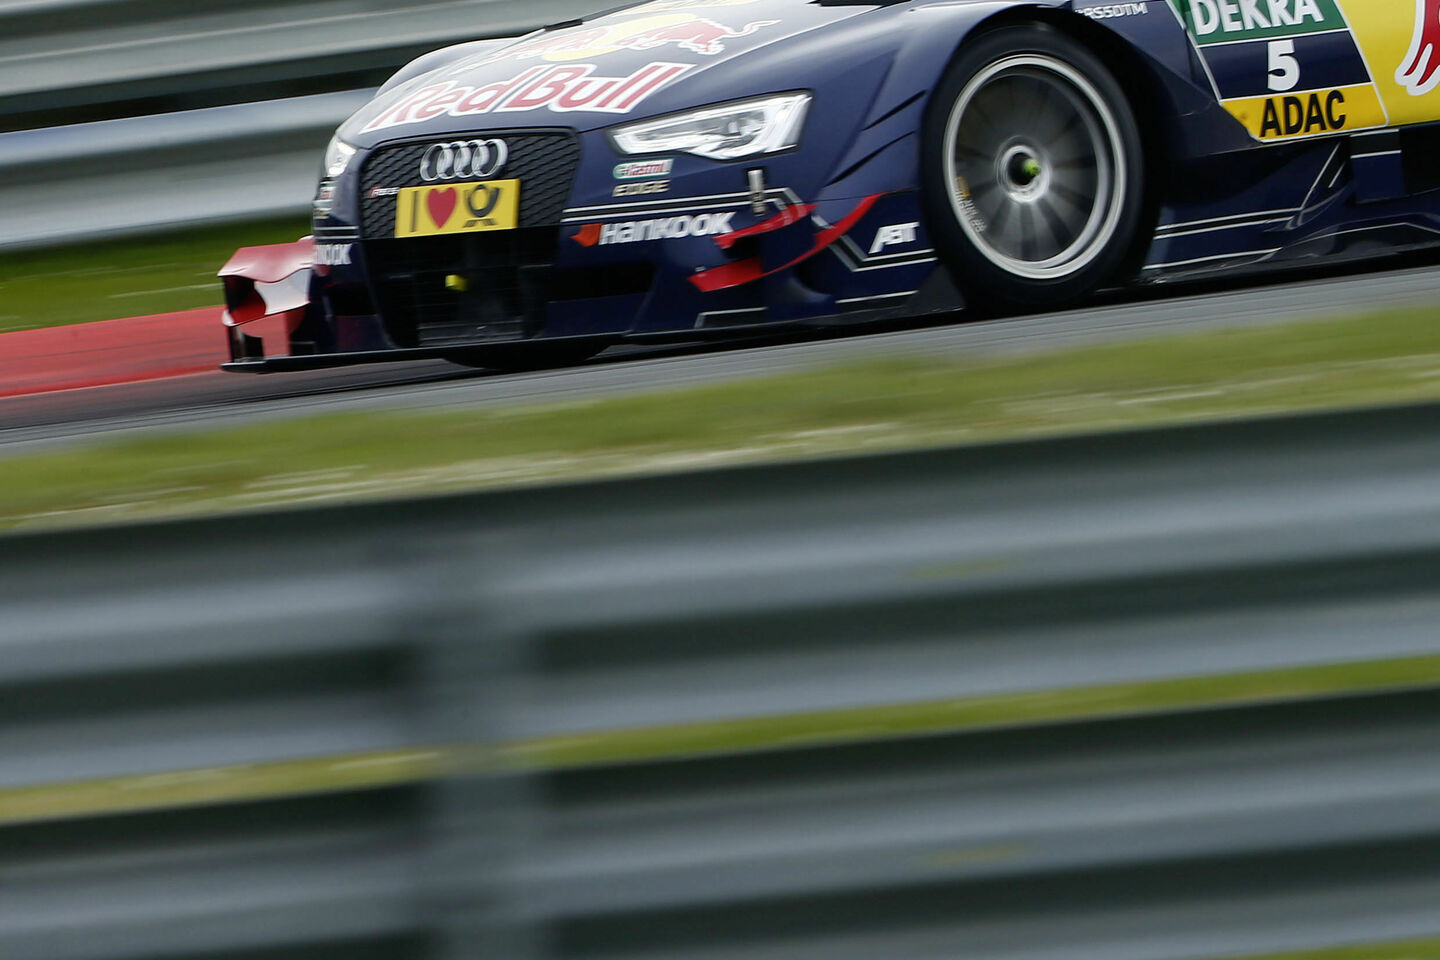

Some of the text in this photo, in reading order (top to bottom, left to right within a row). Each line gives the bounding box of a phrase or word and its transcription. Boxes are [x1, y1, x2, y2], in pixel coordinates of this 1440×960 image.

[1267, 39, 1301, 92] 5
[358, 62, 696, 134] Red Bull
[1259, 90, 1347, 138] ADAC
[409, 190, 418, 233] I
[867, 222, 920, 254] ABT
